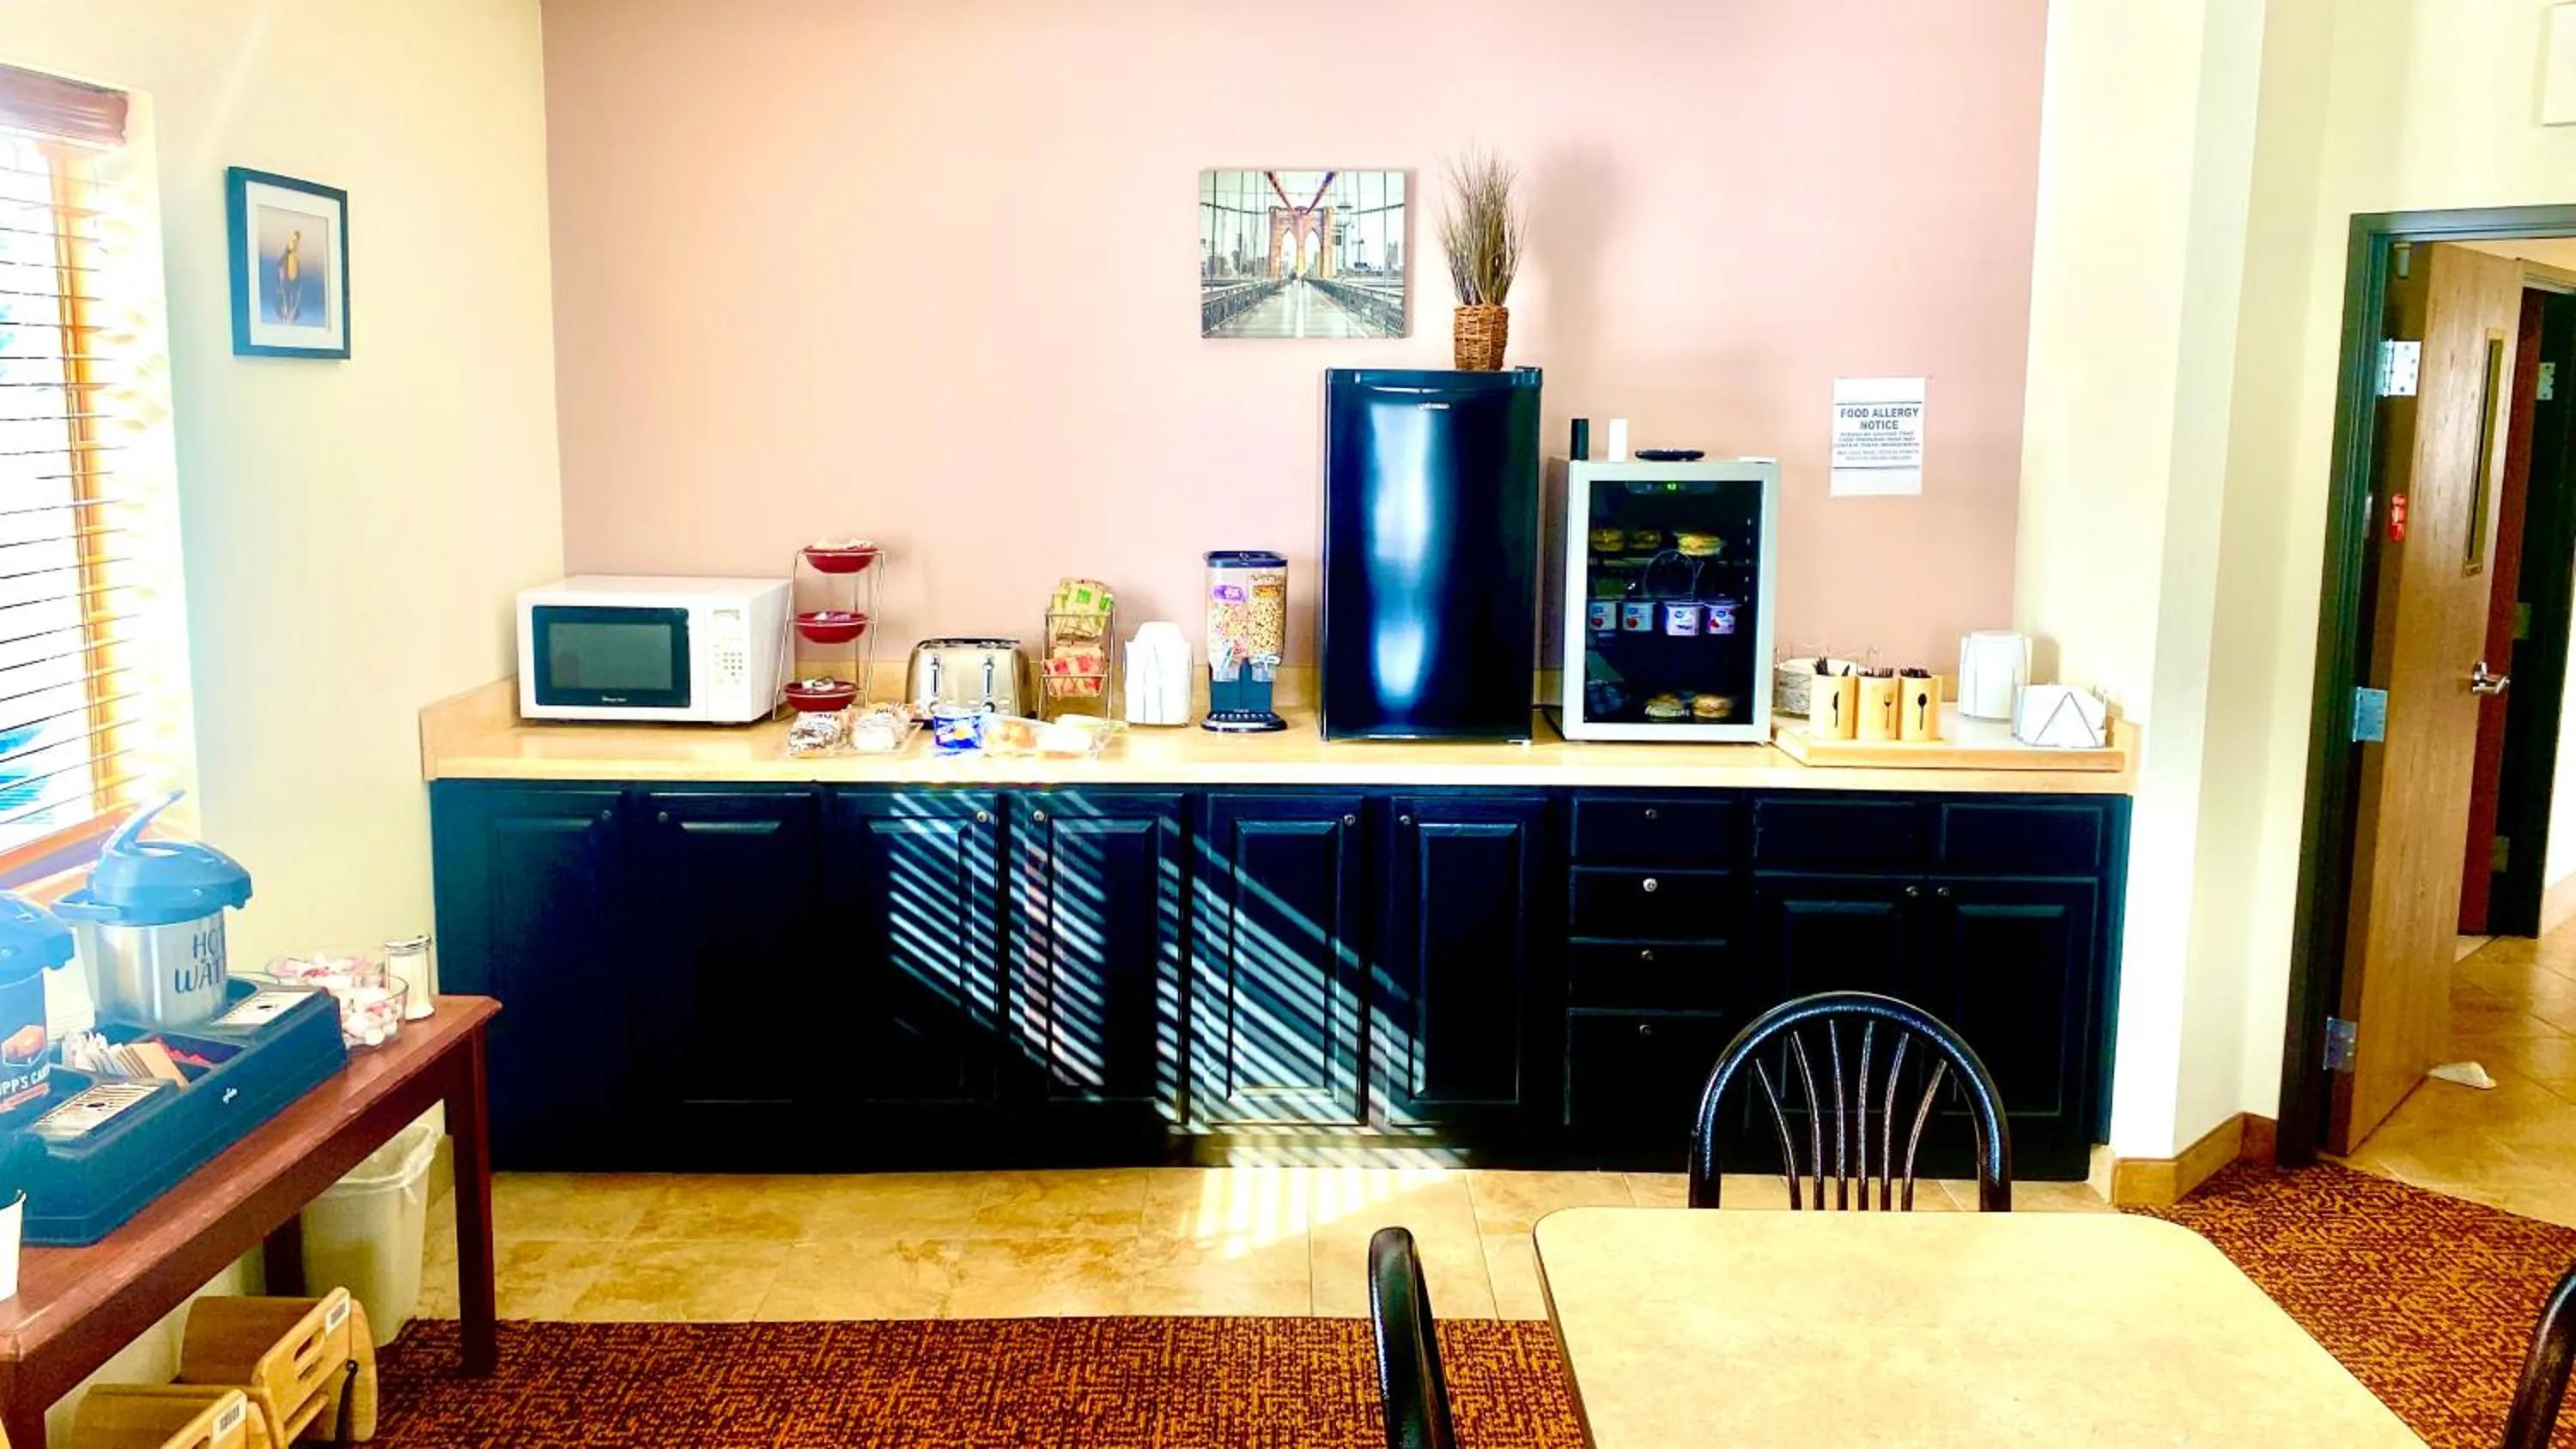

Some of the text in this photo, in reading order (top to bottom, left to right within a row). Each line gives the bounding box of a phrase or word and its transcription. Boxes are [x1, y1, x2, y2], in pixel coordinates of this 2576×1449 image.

[1840, 407, 1920, 418] FOOD ALLERGY
[1859, 420, 1899, 430] NOTICE
[192, 929, 220, 959] HO
[174, 958, 222, 994] WAT
